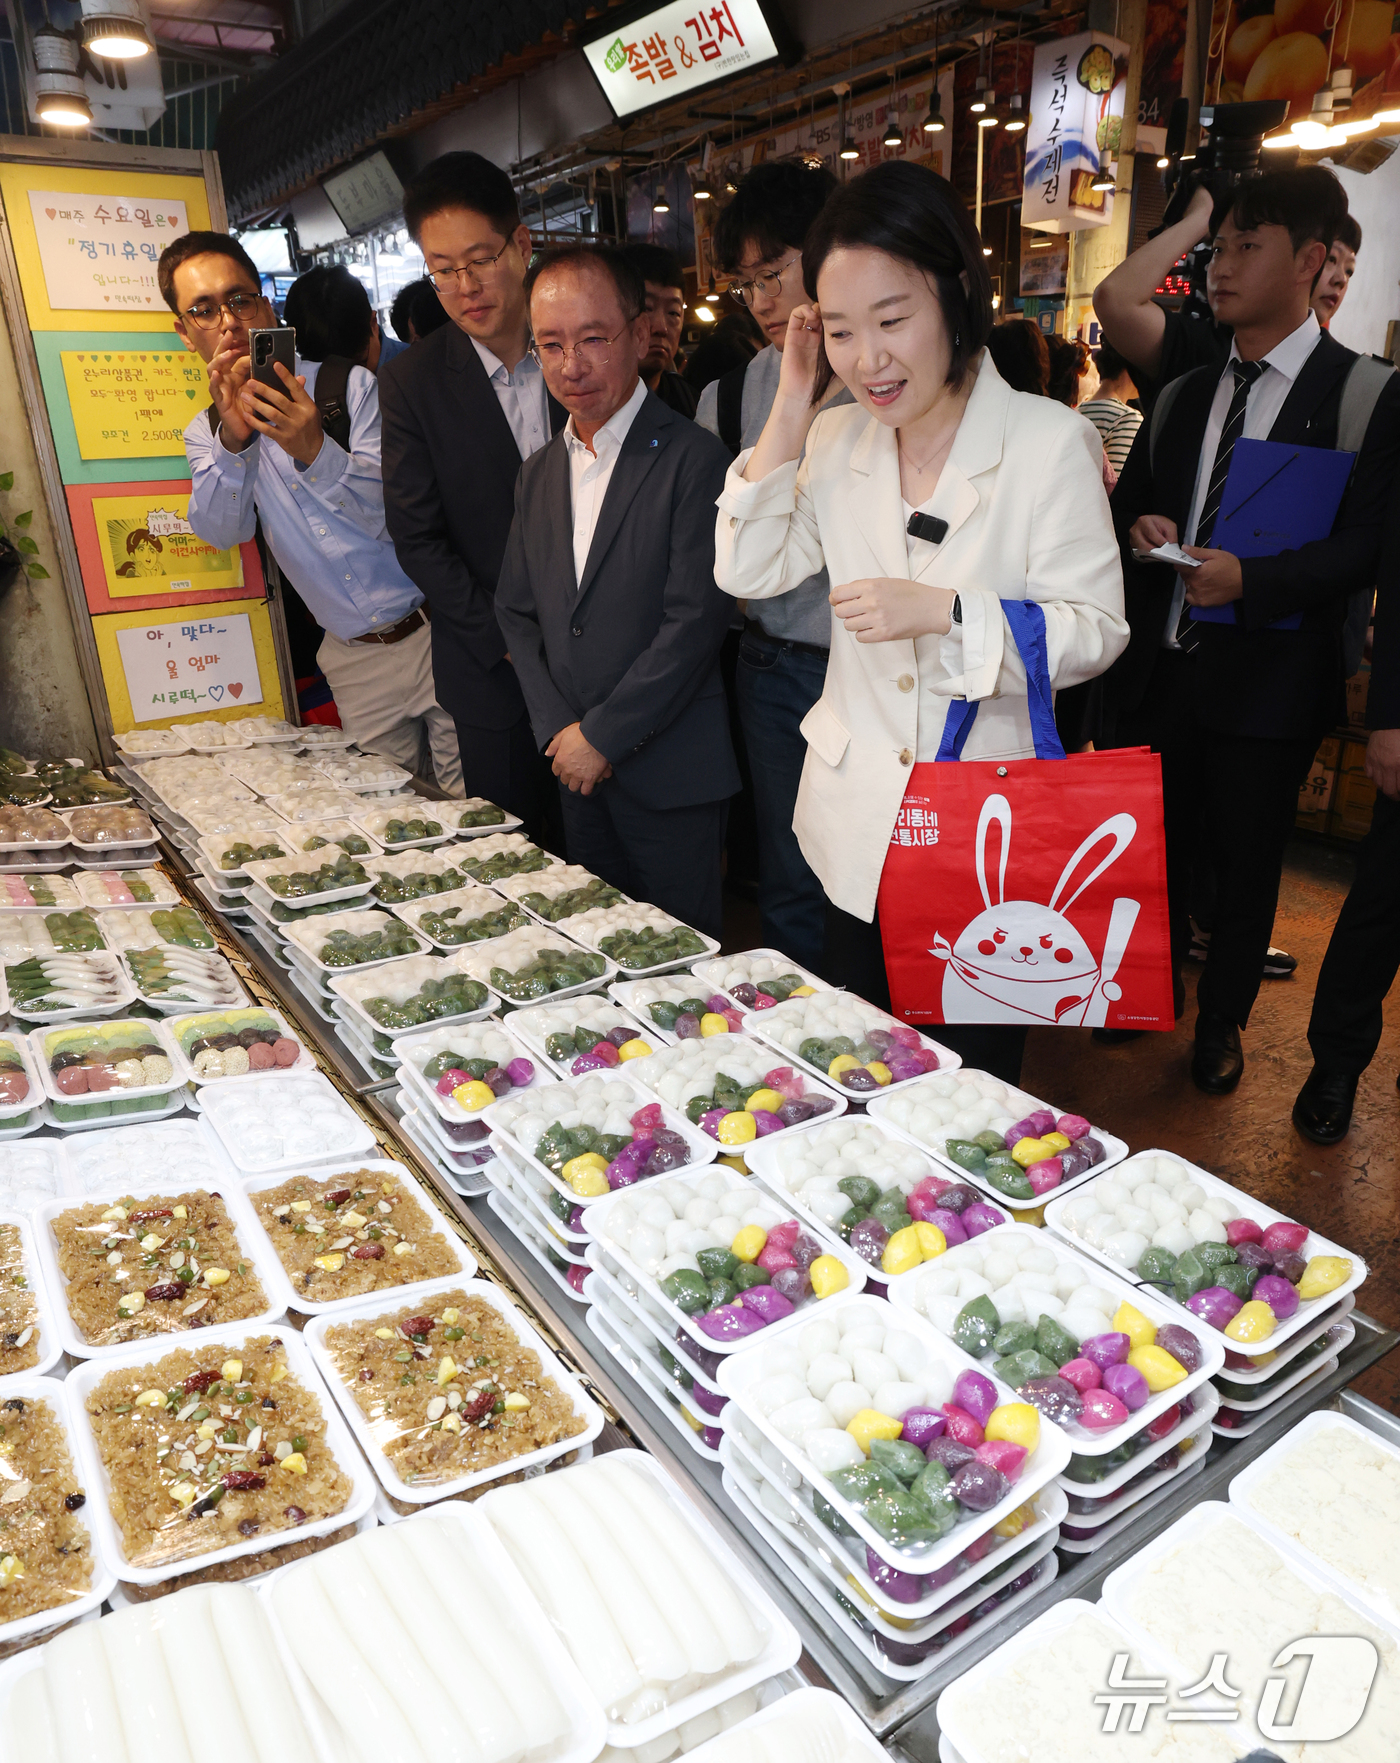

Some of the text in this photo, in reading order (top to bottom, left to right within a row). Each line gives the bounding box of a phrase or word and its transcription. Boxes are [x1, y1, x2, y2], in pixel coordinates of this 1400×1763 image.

[684, 0, 745, 62] 김치
[622, 32, 678, 85] 족발
[674, 35, 698, 69] &
[1041, 54, 1068, 204] 즉석수제전
[58, 204, 167, 228] 매주 수요일은
[182, 368, 202, 382] 현금
[134, 409, 163, 422] 1팩에
[101, 429, 130, 443] 무조건
[166, 654, 221, 680] 울 엄마
[897, 808, 938, 827] 리동네
